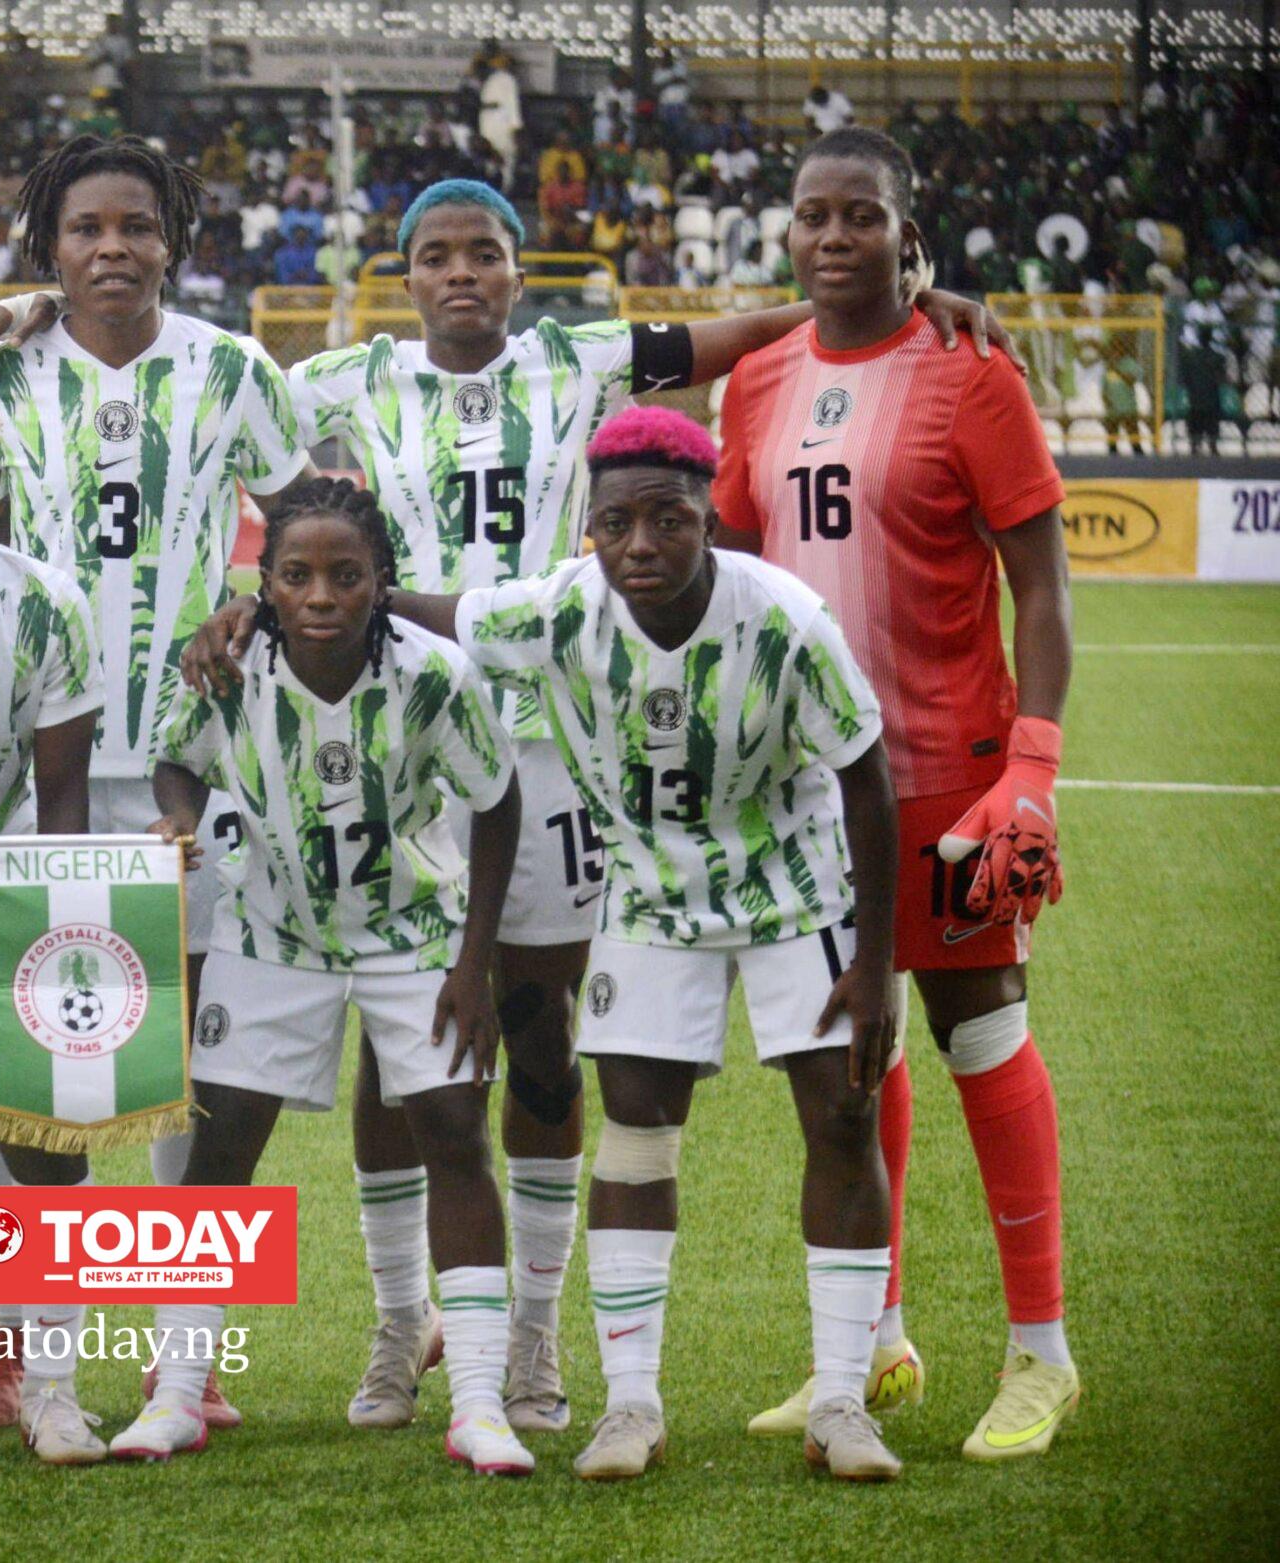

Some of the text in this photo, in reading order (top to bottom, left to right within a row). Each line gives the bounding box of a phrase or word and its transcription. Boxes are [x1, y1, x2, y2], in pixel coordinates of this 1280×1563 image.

[96, 482, 140, 559] 3
[448, 467, 525, 544] 15
[786, 463, 852, 541] 16
[628, 763, 703, 828] 13
[5, 849, 151, 880] NIGERIA
[306, 821, 392, 889] 12
[546, 808, 604, 887] 15
[28, 928, 103, 963] FOOTBALL
[20, 967, 40, 1032] NIGERIA
[107, 939, 145, 1030] FEDERATION
[64, 1041, 102, 1054] 1945
